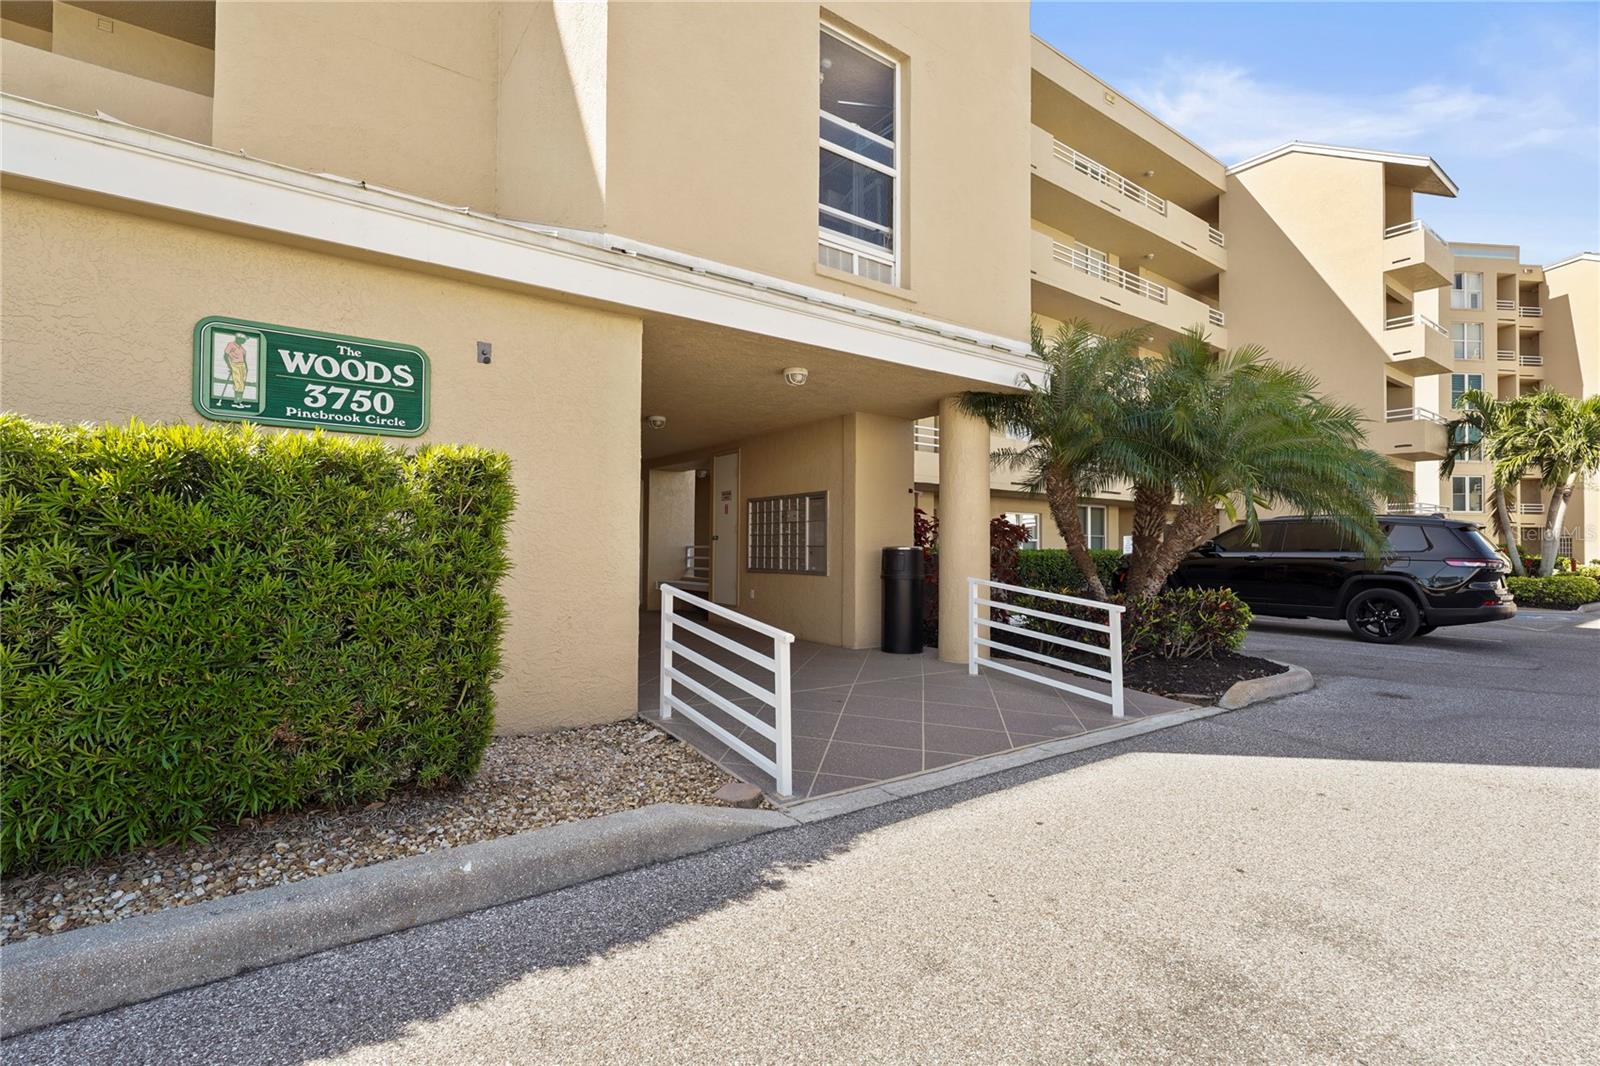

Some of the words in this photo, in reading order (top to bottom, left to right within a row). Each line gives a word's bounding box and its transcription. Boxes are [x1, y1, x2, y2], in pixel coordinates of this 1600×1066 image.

[336, 345, 362, 358] The
[278, 349, 415, 387] WOODS
[303, 383, 394, 415] 3750
[285, 406, 361, 423] Pinebrook
[364, 414, 406, 427] Circle
